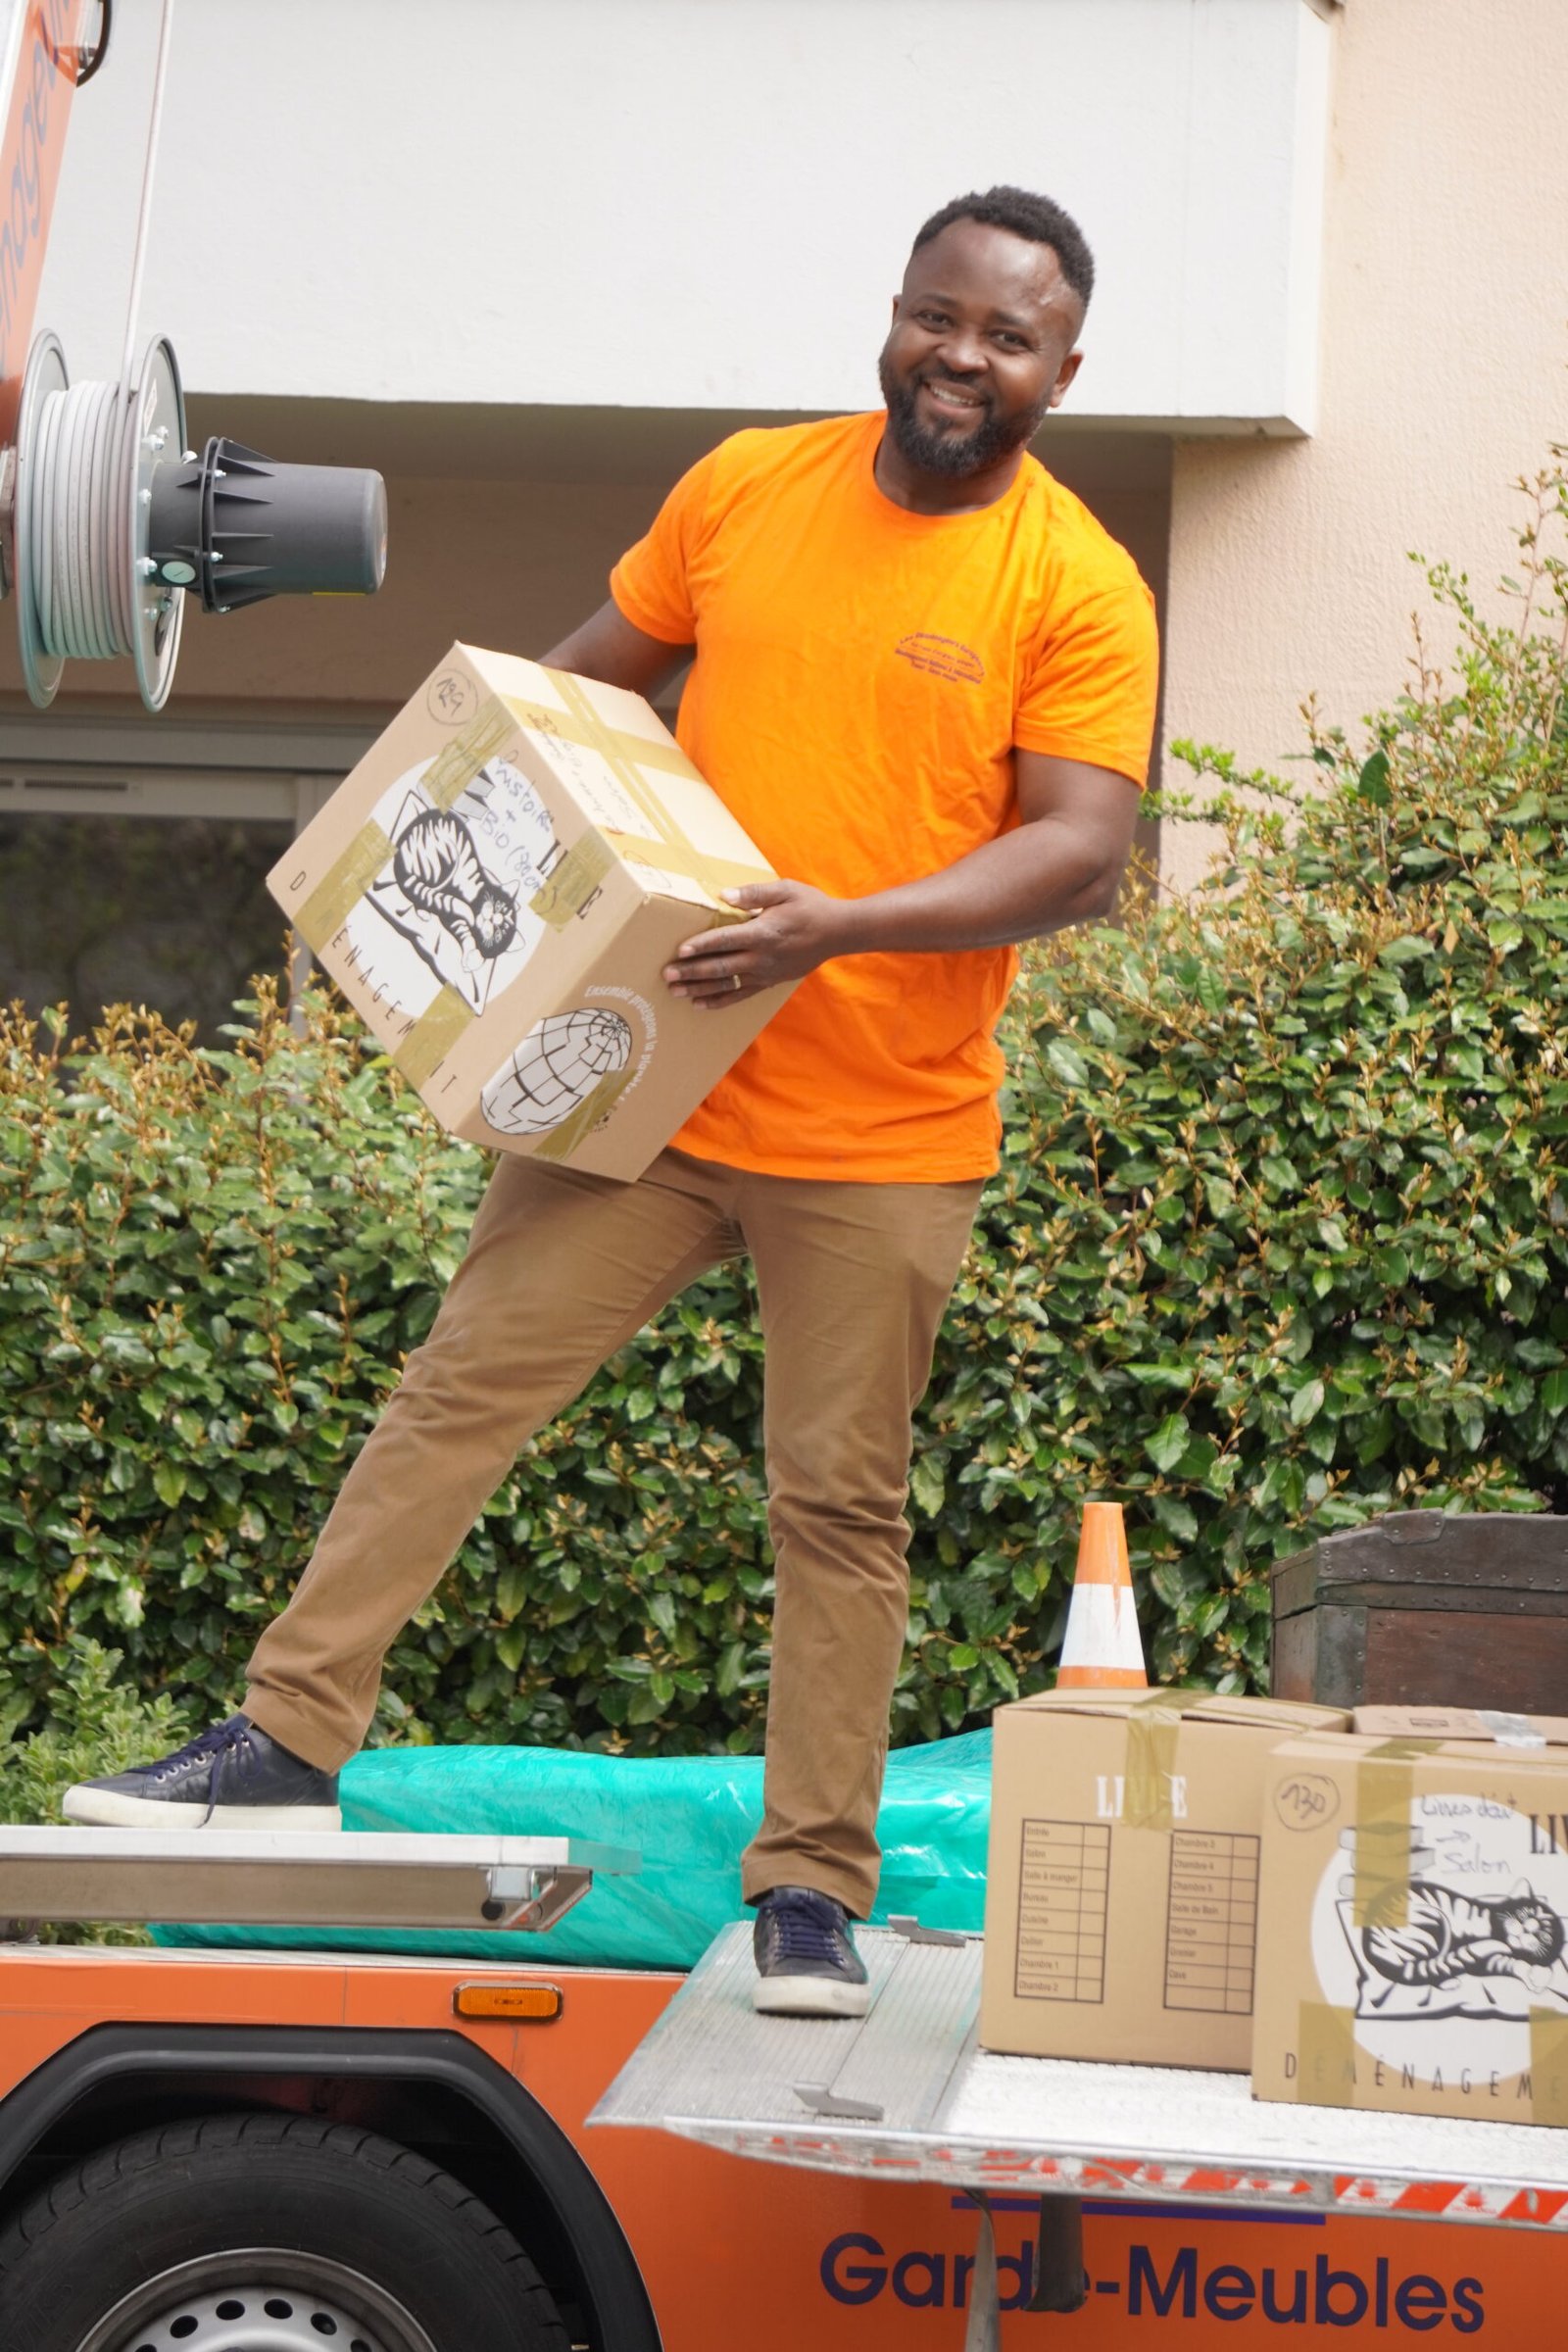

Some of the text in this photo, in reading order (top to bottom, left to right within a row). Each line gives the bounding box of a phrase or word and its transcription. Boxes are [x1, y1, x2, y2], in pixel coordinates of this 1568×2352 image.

[536, 839, 604, 919] LIE
[1096, 1775, 1188, 1820] LIE
[1281, 1783, 1326, 1821] 130
[819, 2230, 1486, 2334] Gard-Meubles
